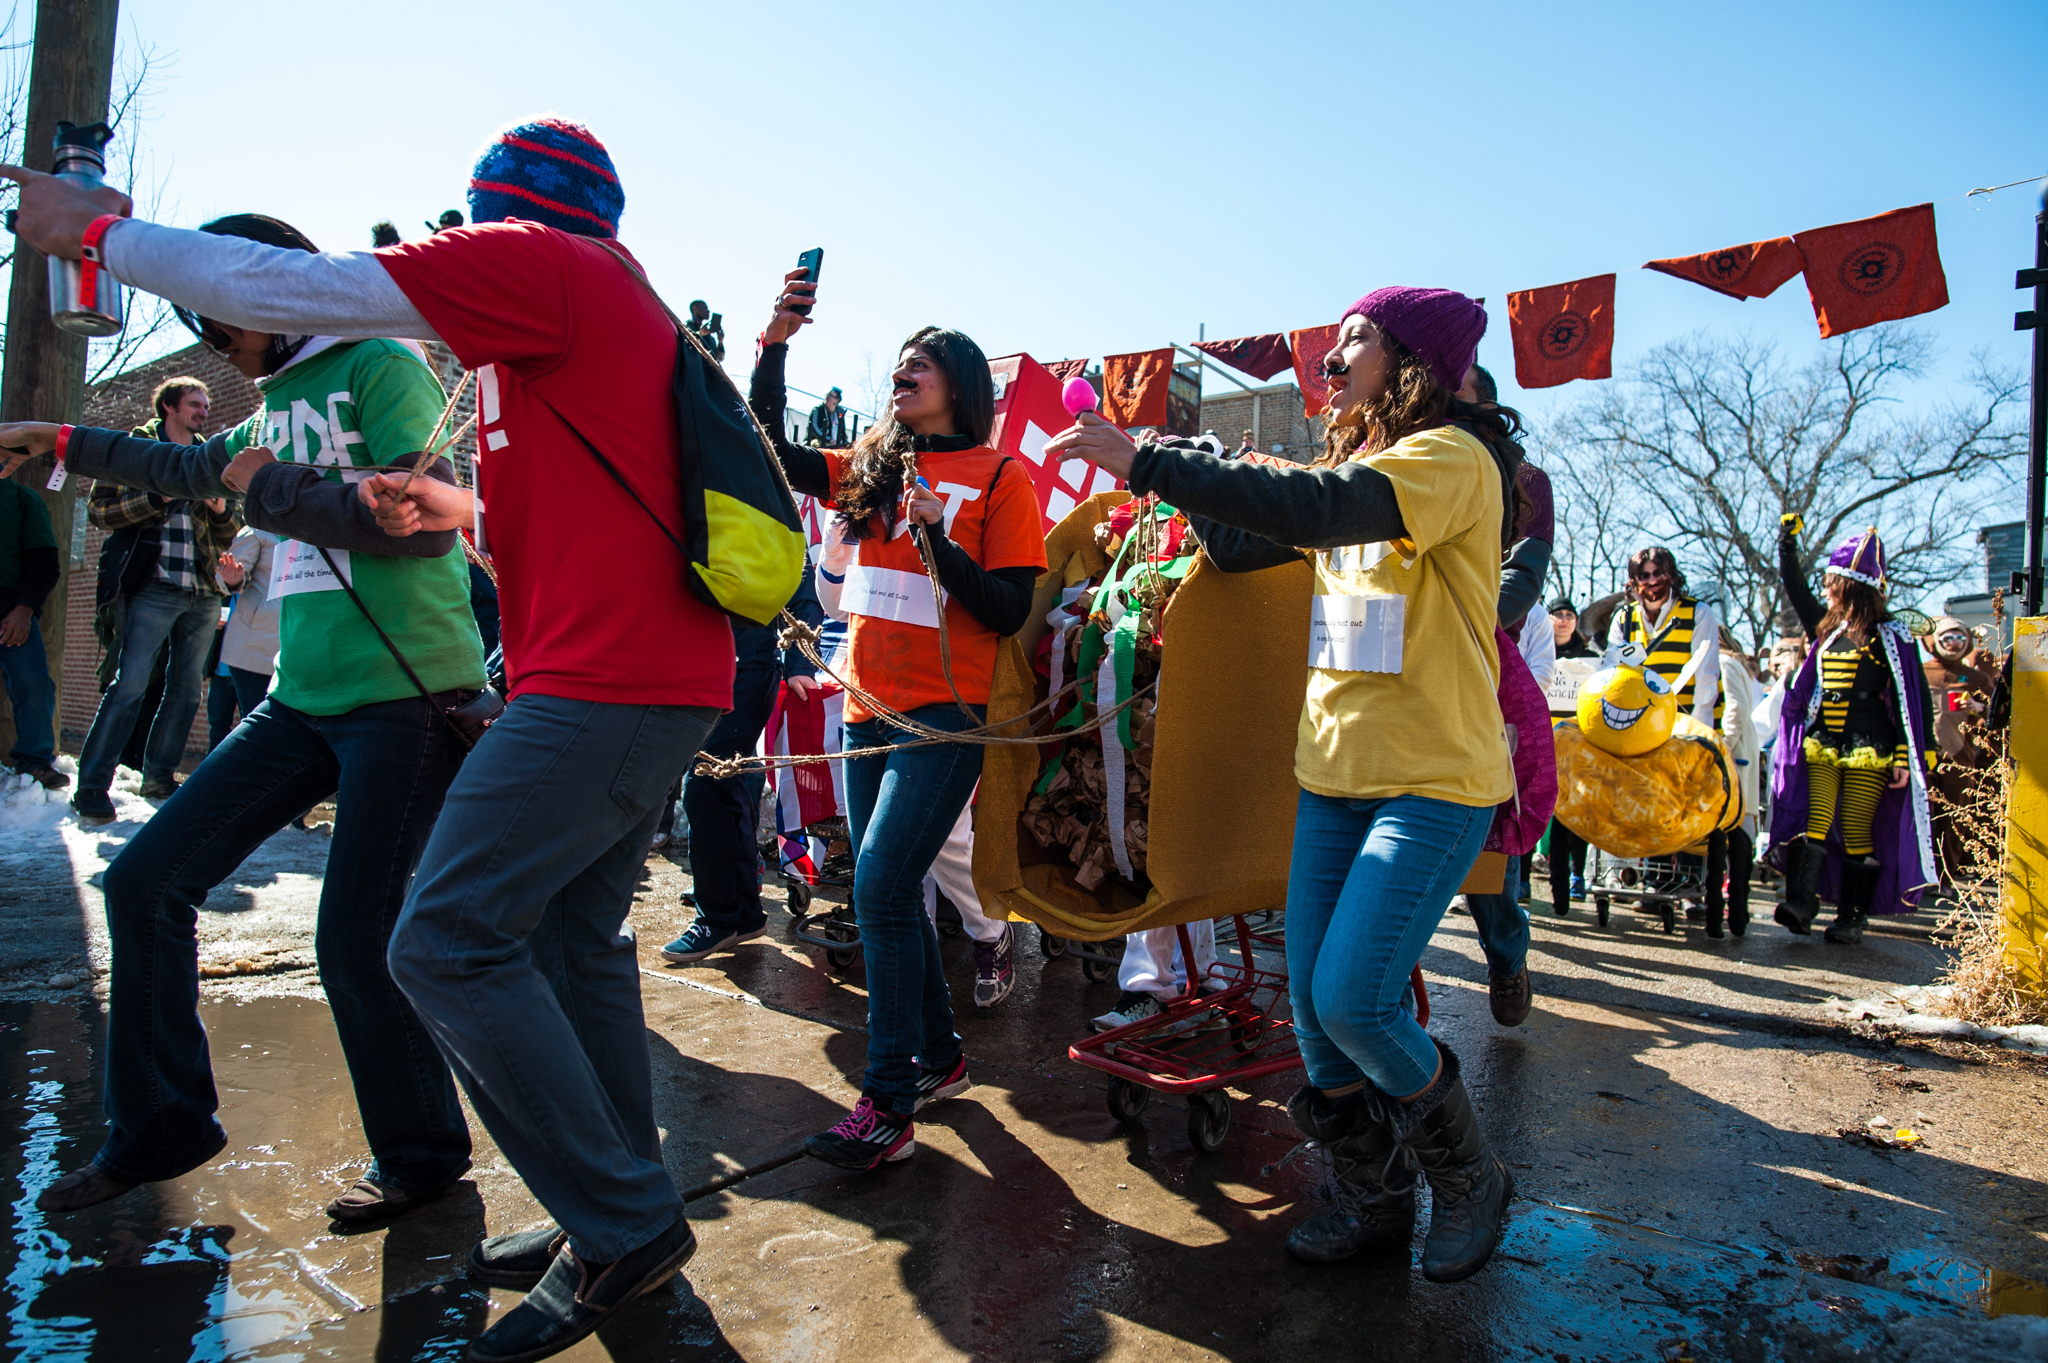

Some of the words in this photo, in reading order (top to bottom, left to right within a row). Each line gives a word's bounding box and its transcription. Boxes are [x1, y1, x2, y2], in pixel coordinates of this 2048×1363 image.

[295, 570, 303, 579] all
[304, 570, 315, 578] the
[1350, 619, 1363, 627] out
